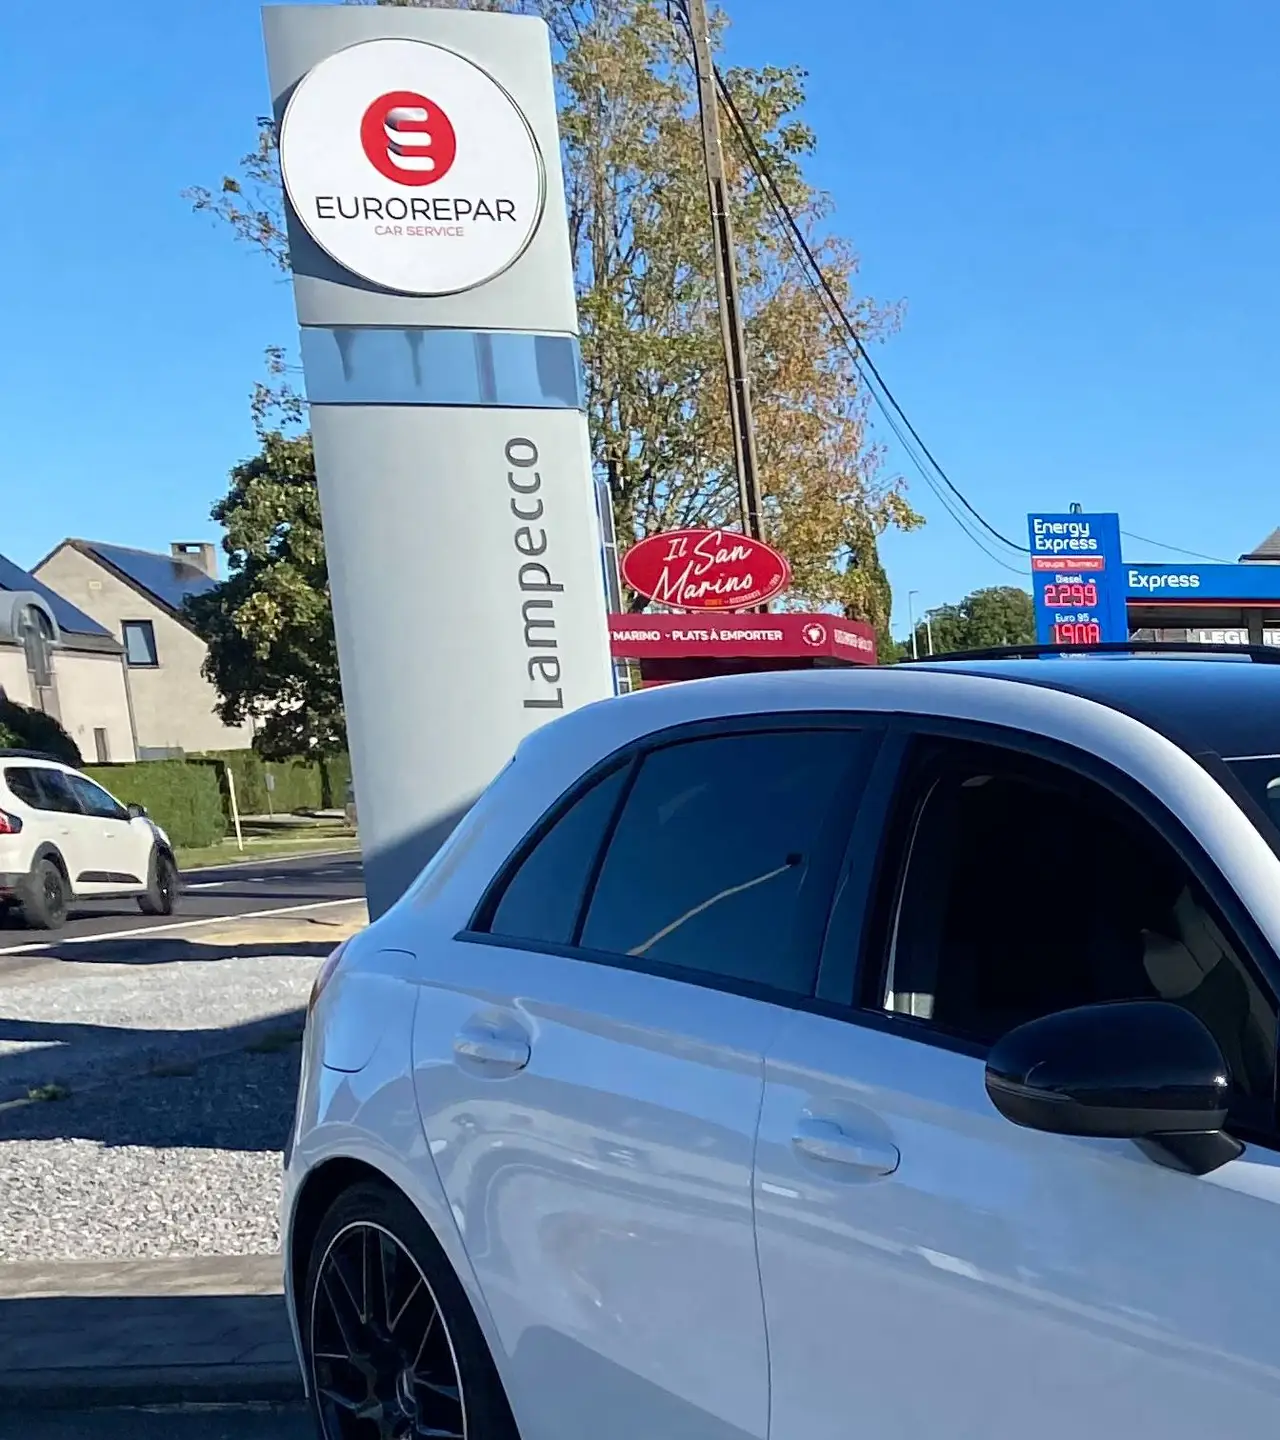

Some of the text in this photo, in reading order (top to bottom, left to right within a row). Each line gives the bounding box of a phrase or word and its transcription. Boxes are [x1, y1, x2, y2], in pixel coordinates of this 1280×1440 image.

[315, 196, 517, 221] EUROREPAR
[375, 225, 465, 237] CAR SERVICE
[1033, 518, 1090, 537] Energy
[694, 530, 752, 576] San
[1035, 536, 1098, 553] Express
[504, 437, 564, 708] Lampecco
[1055, 574, 1083, 584] Diesel
[1128, 571, 1200, 591] Express
[651, 561, 753, 604] Marino
[1055, 613, 1076, 623] Euro
[613, 630, 661, 641] MARINO
[672, 630, 709, 641] PLATS
[720, 630, 783, 641] EMPORTER
